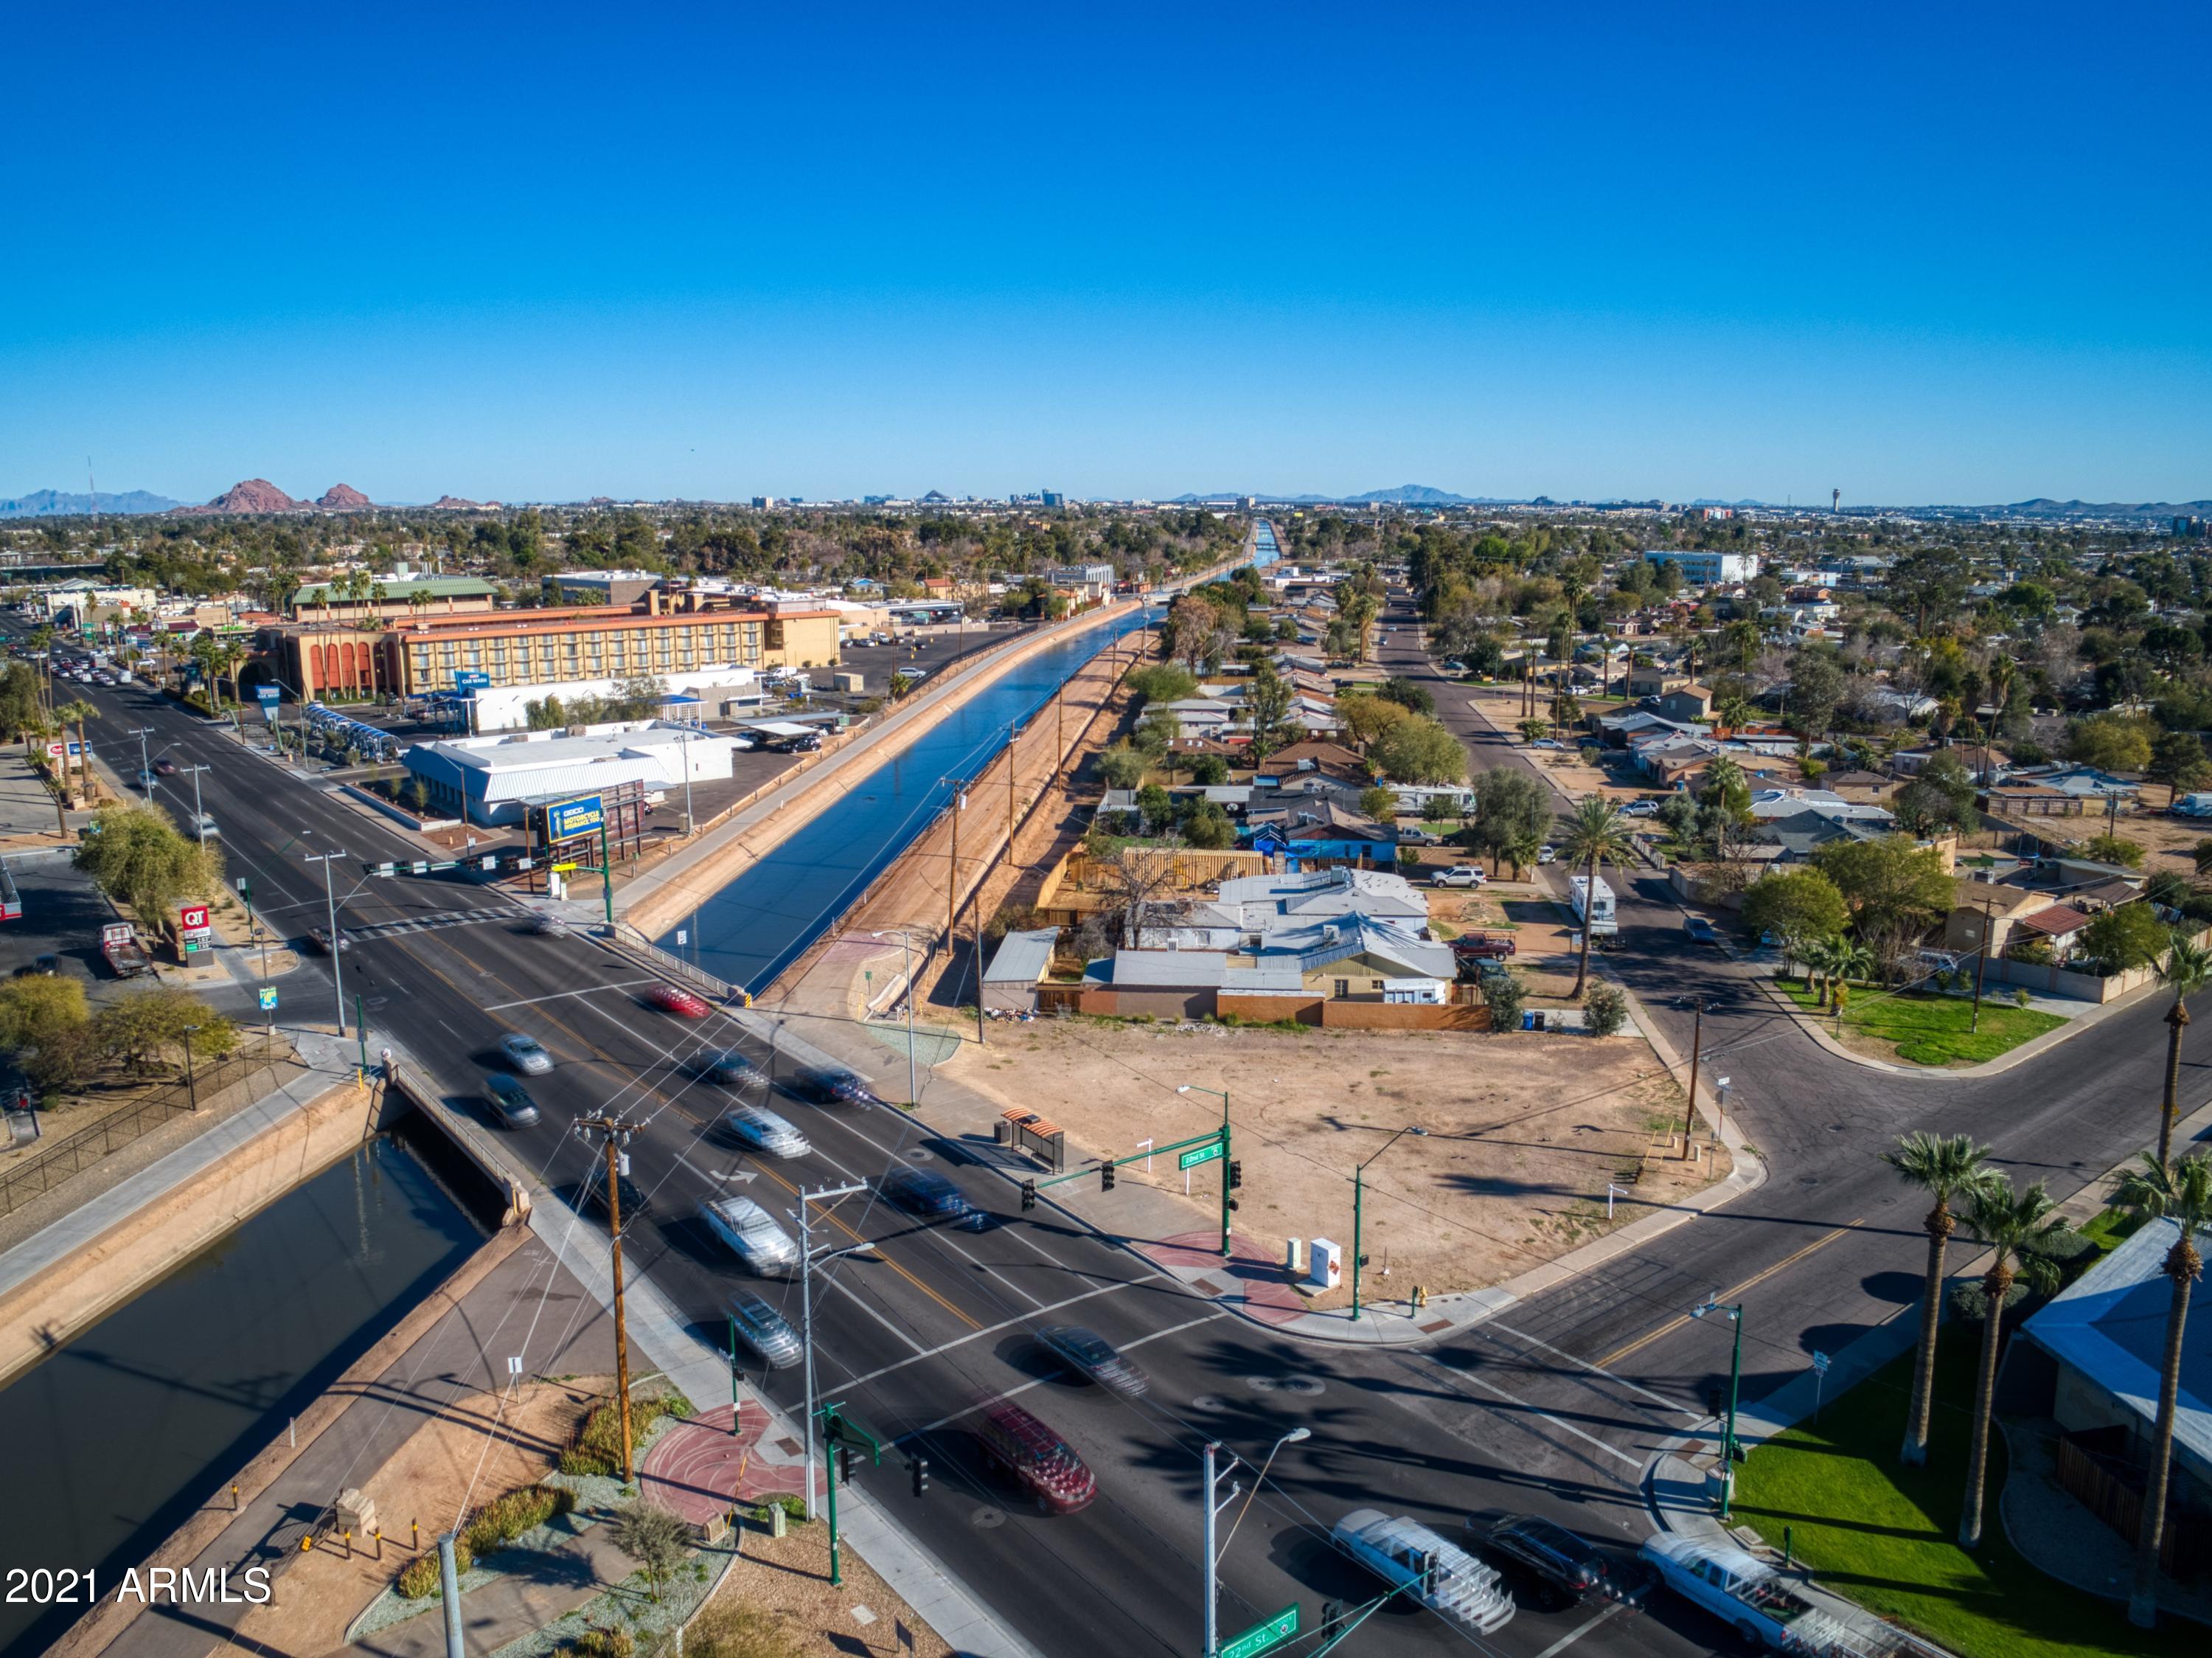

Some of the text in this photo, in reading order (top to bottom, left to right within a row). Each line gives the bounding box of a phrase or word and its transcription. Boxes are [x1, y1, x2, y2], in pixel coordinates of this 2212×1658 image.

[563, 807, 584, 816] GEICO
[564, 811, 599, 825] MOTORCYCLE
[185, 910, 204, 926] QT
[1186, 1154, 1199, 1164] 22nd
[1228, 1641, 1251, 1658] 22nd
